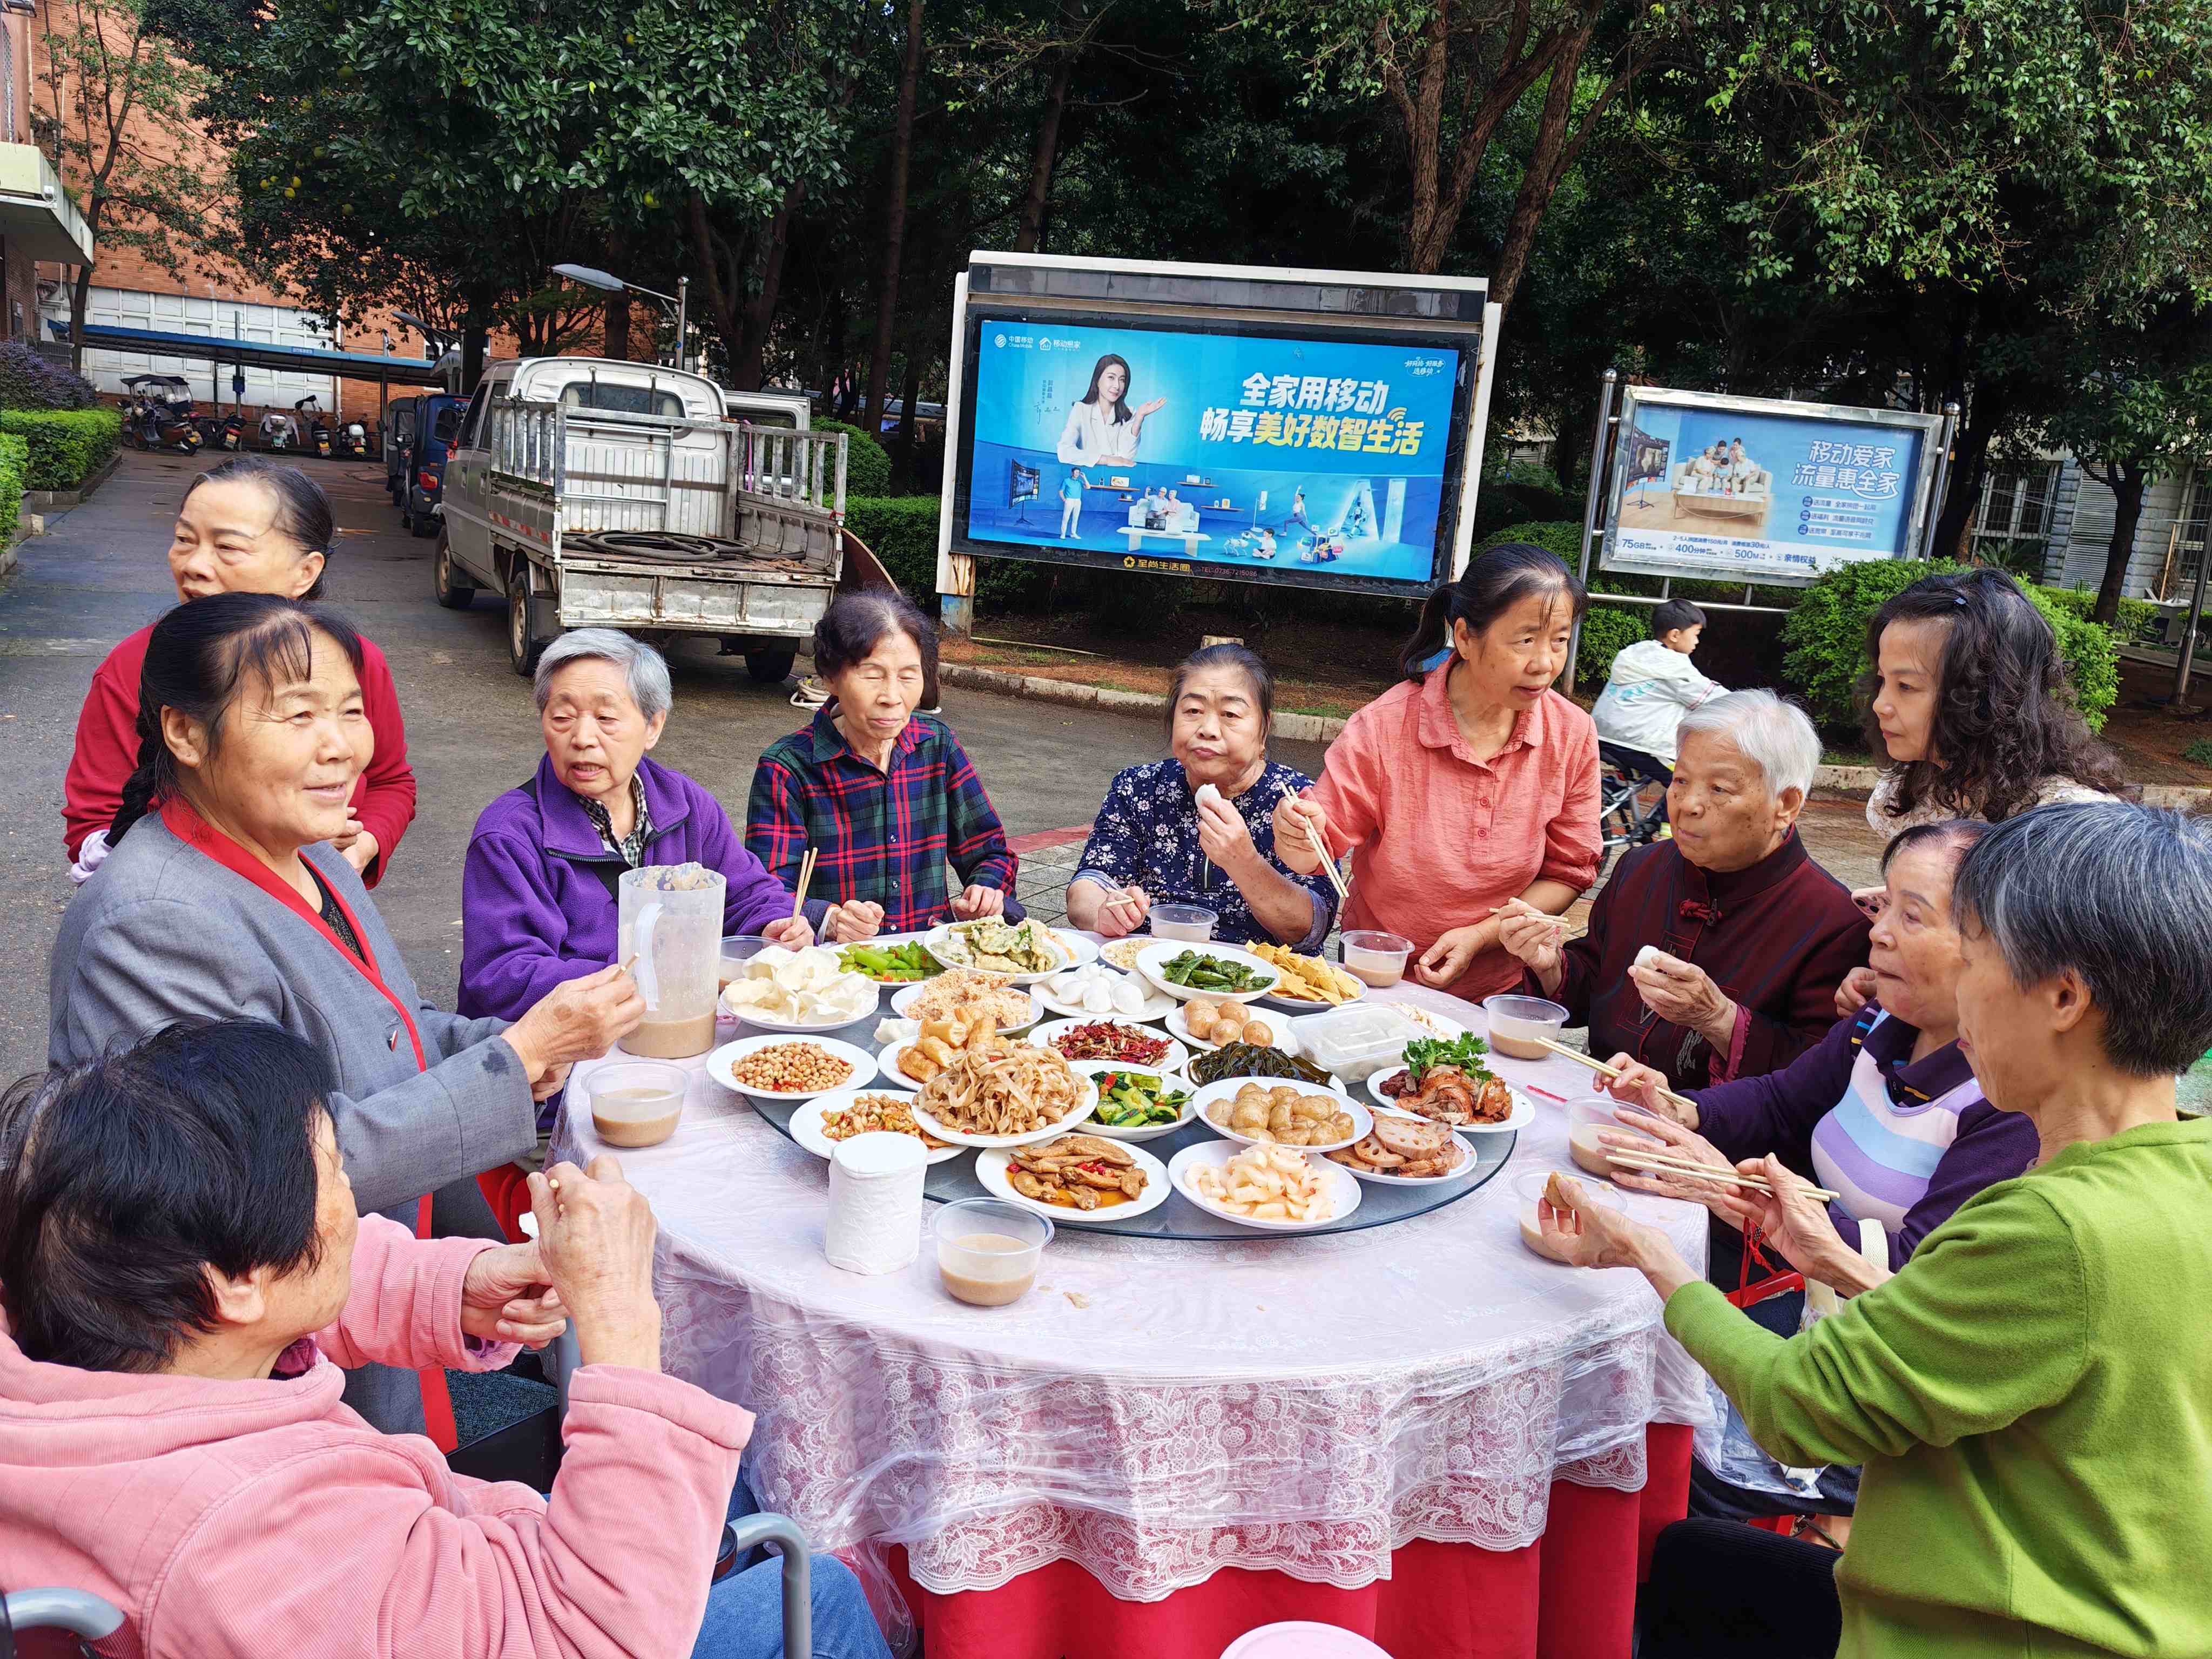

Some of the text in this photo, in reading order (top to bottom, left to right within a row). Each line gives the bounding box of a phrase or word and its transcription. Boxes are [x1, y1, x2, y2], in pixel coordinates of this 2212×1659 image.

[1008, 335, 1034, 343] 中国移动
[1240, 372, 1390, 415] 全家用移动
[1199, 406, 1424, 455] 畅享美好数智生活
[1809, 440, 1896, 469] 移动爱家
[1791, 463, 1900, 500] 流量惠全家
[1622, 539, 1645, 549] 75GB
[1137, 559, 1190, 572] 至尚生活圈
[1784, 554, 1816, 564] 亲情权益
